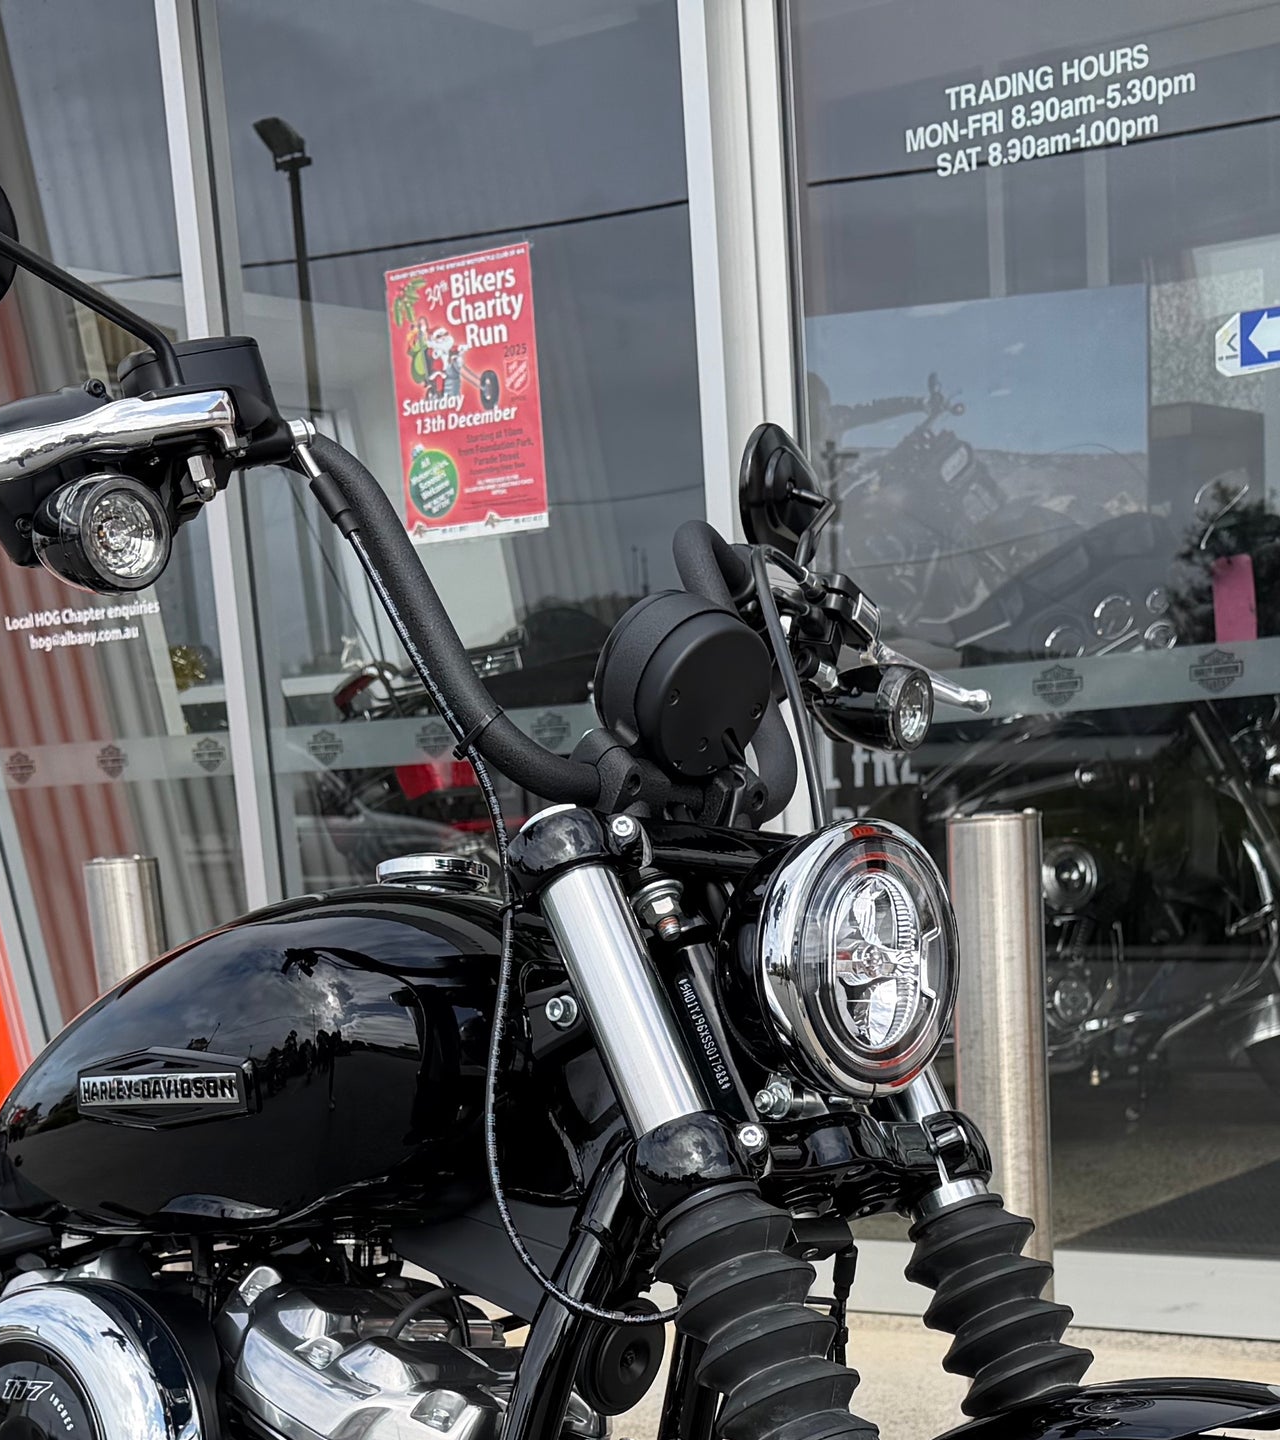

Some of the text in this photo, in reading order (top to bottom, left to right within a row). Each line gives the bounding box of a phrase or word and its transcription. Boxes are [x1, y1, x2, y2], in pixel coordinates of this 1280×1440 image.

[945, 43, 1149, 111] TRADING HOURS
[905, 71, 1196, 153] MON-FRI 8.30am-5.30pm
[936, 113, 1159, 177] SAT 8.30am-1.00pm
[450, 266, 516, 298] Bikers
[446, 291, 524, 326] Charity
[465, 323, 508, 349] Run
[402, 393, 465, 417] Saturday
[415, 404, 518, 436] 13th December
[4, 600, 160, 631] Local HOG Chapter enquiries
[82, 1078, 236, 1102] HARLEY-DAVIDSON
[2, 1378, 53, 1401] 117
[49, 1393, 74, 1432] INCHES
